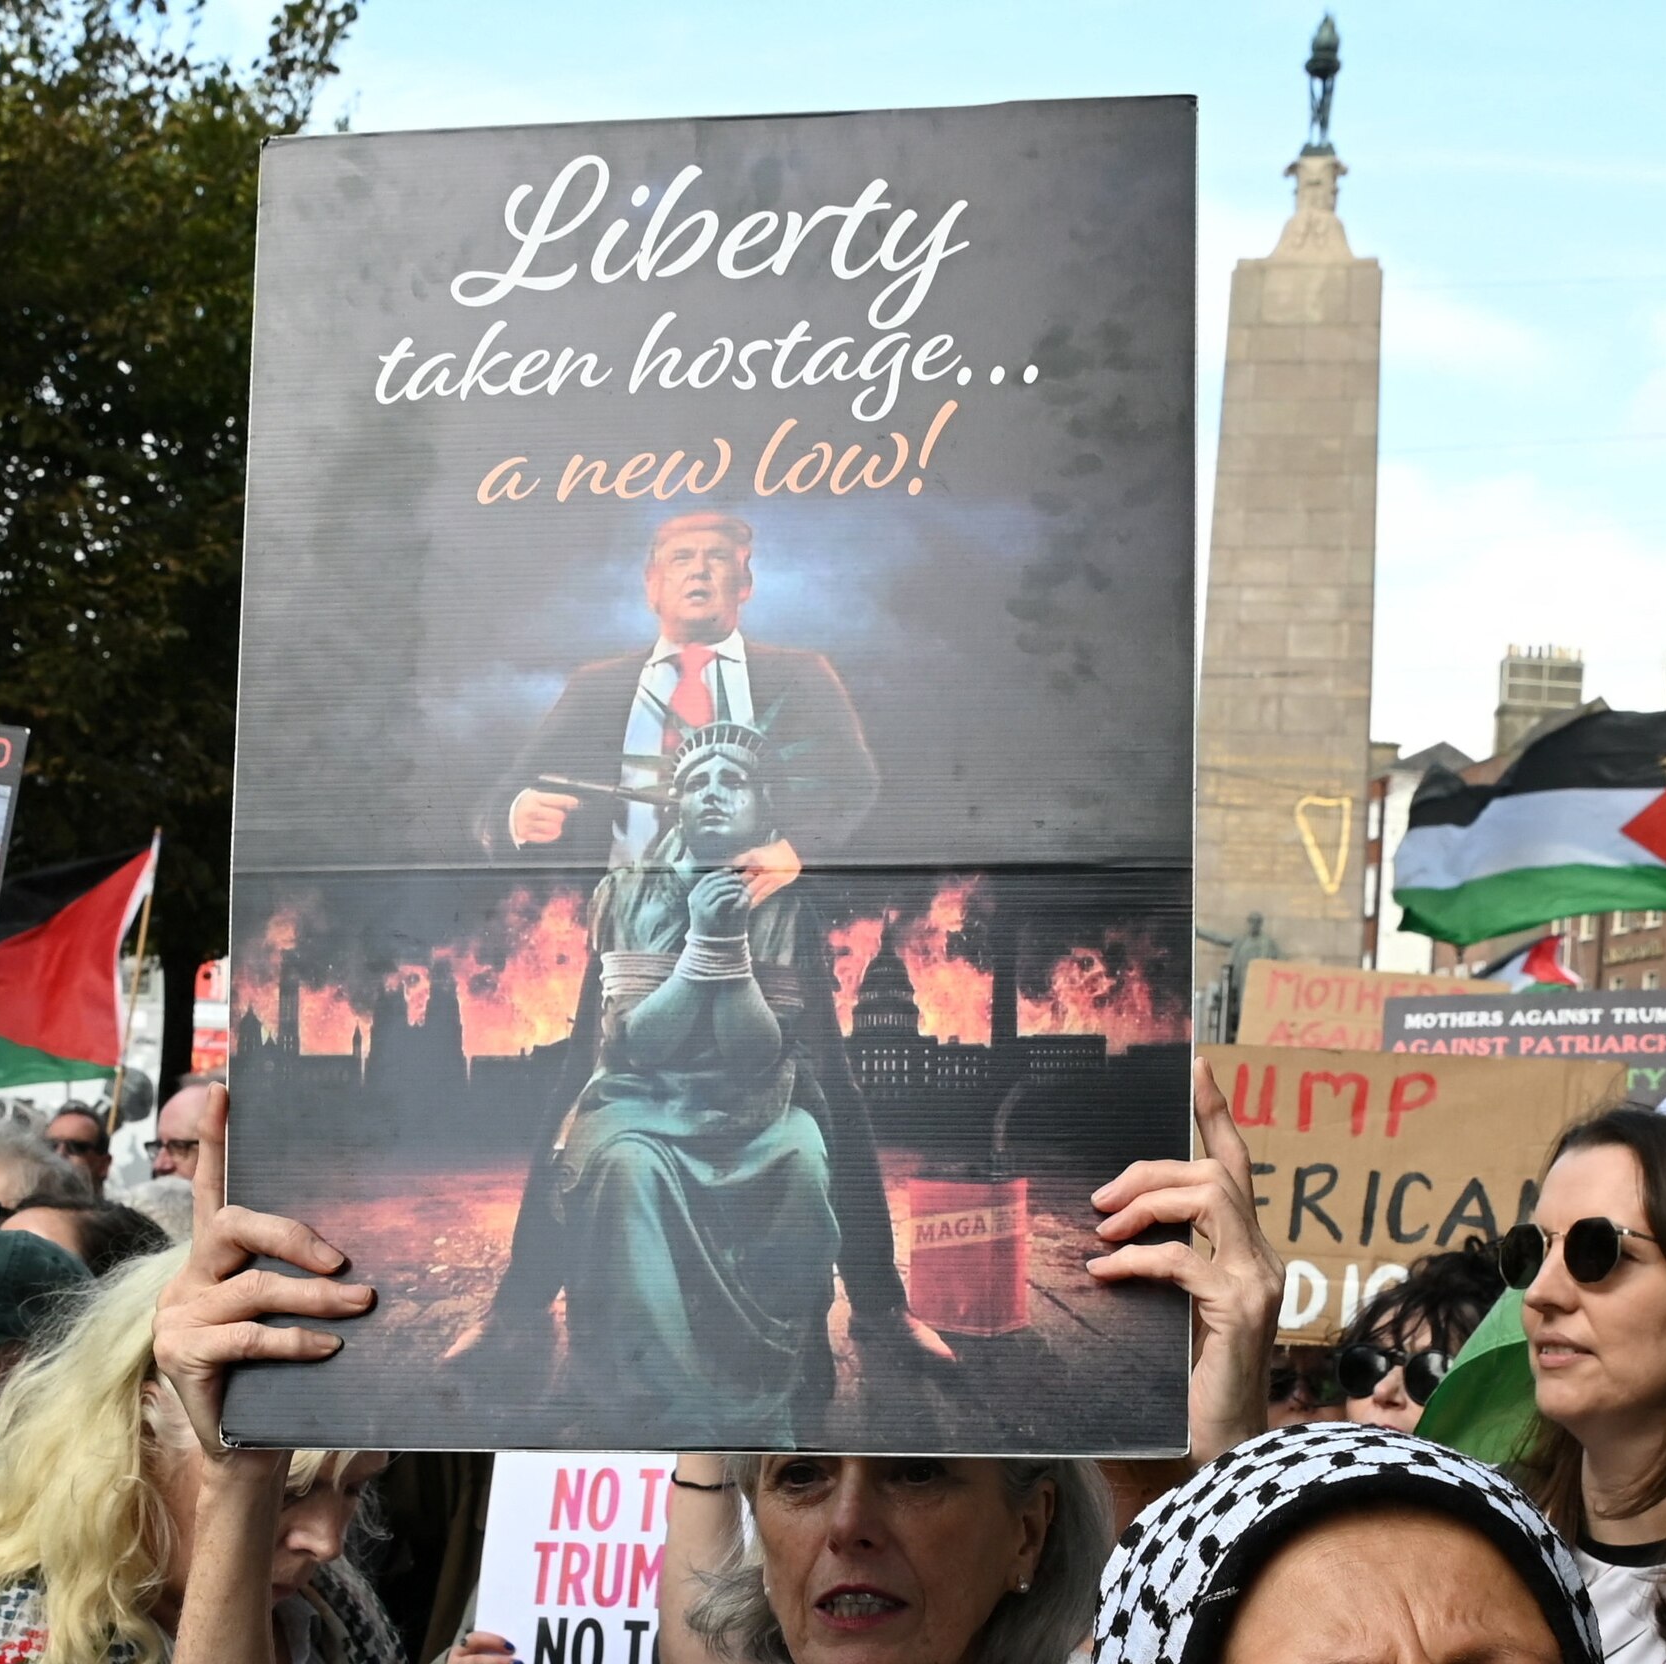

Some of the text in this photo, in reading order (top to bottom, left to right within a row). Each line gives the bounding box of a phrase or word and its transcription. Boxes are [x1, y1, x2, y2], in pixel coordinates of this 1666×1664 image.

[450, 154, 969, 329] Liberty
[375, 311, 1040, 423] taken hostage...
[476, 400, 960, 505] a new low!
[1391, 1035, 1510, 1056] AGAINST
[1404, 1009, 1503, 1029] MOTHERS
[1509, 1007, 1603, 1027] AGAINST
[915, 1214, 987, 1244] MAGA
[549, 1468, 620, 1532] NO
